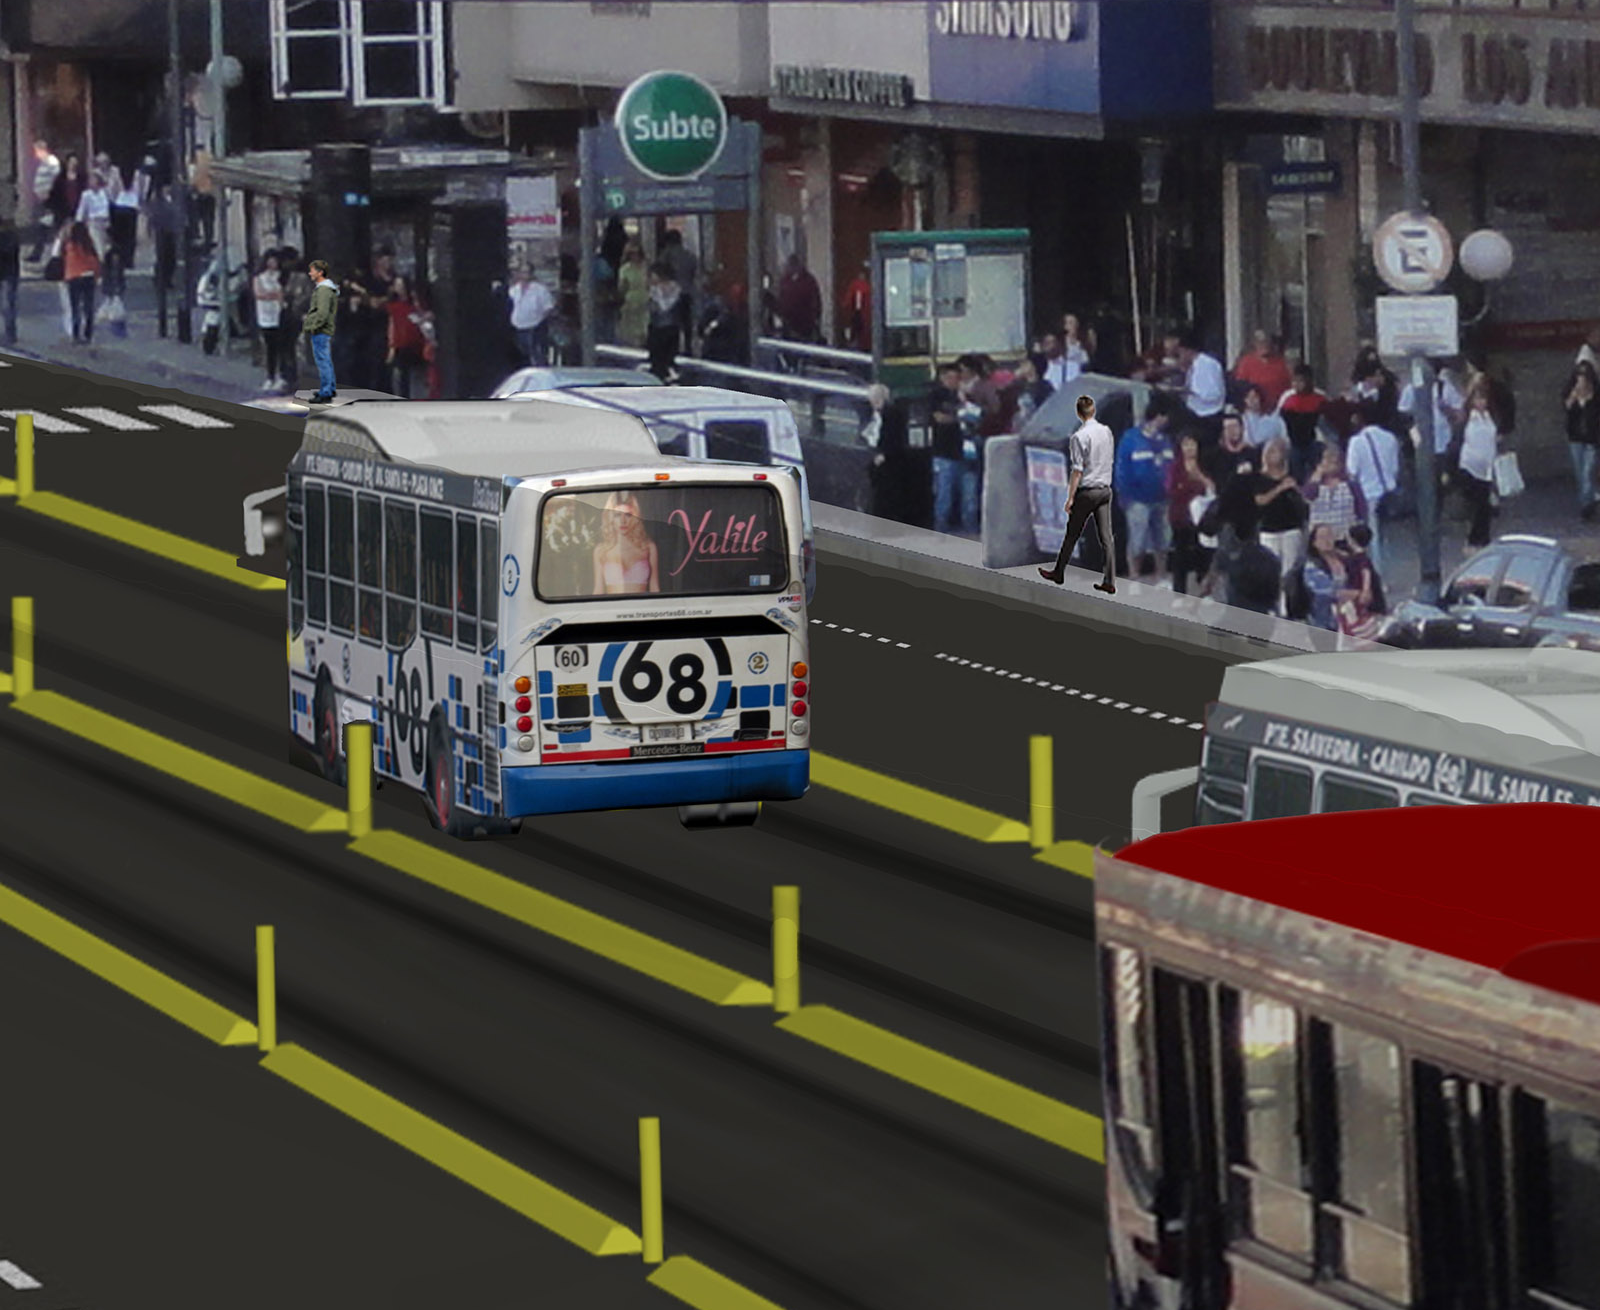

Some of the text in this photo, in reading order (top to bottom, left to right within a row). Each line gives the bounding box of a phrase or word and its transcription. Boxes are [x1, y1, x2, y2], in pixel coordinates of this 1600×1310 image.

[633, 110, 716, 140] Subte
[667, 507, 769, 577] Yalile
[615, 609, 713, 620] www.transportes68.com.ar
[561, 649, 580, 667] 60
[752, 656, 768, 670] 2
[619, 641, 708, 715] 68
[633, 741, 703, 757] Mercedes-Benz
[1291, 726, 1361, 767] SAAVEDRA
[1370, 747, 1431, 784] CABILDO
